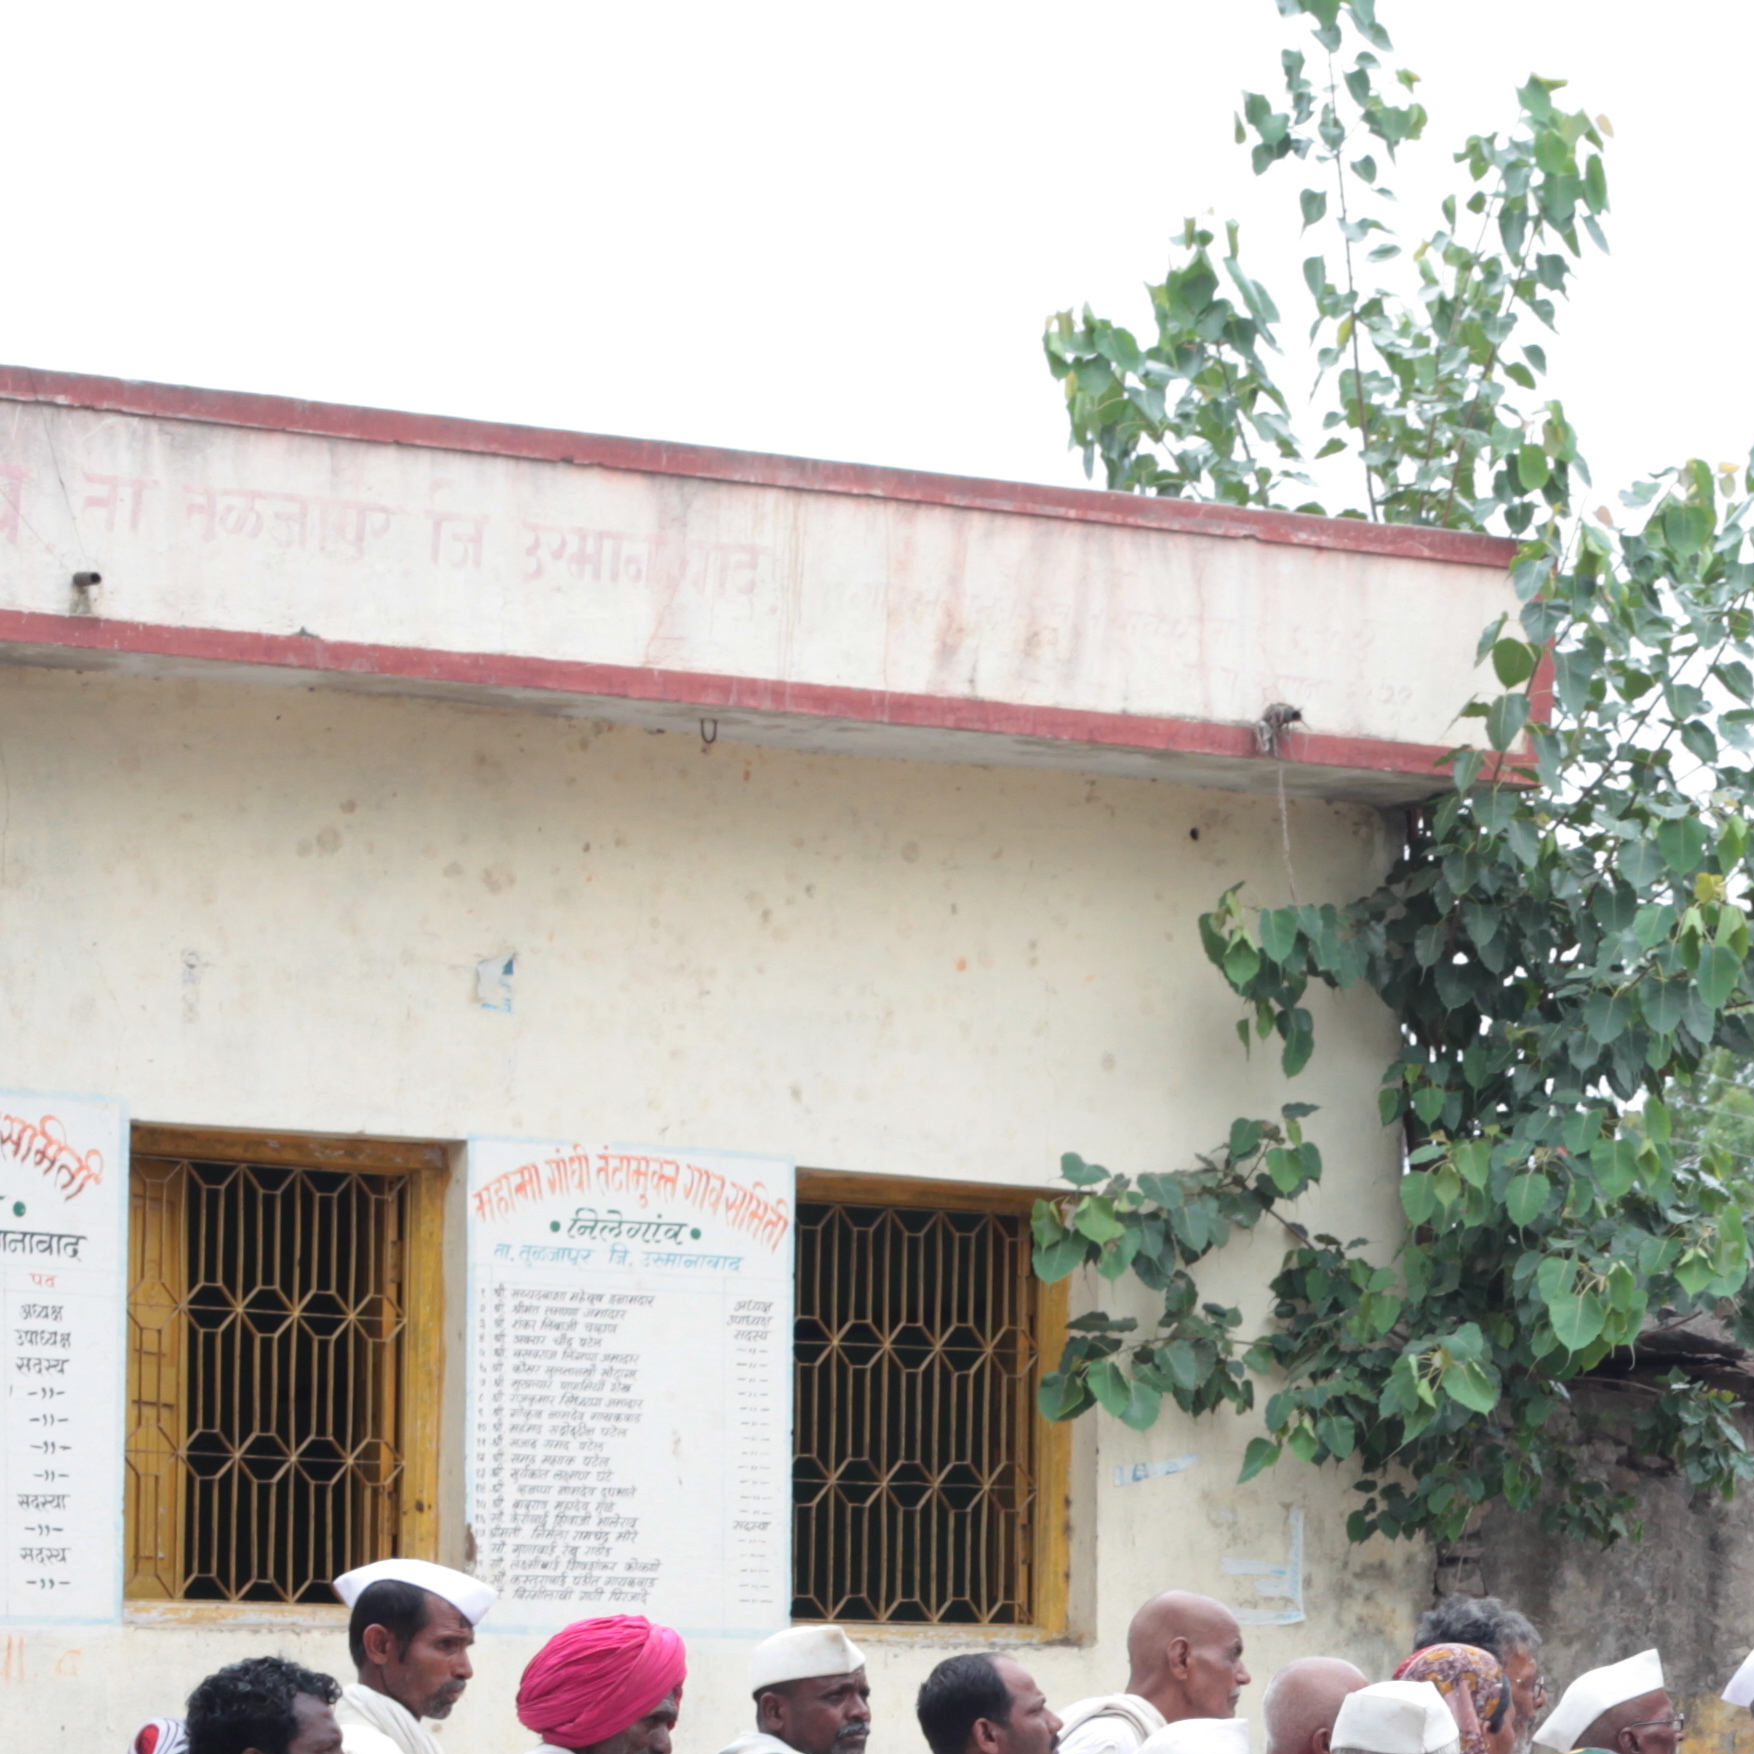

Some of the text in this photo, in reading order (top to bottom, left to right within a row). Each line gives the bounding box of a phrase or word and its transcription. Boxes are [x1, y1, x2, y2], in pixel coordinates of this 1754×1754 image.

[29, 1272, 57, 1288] पद
[20, 1303, 64, 1322] अध्यक्ष
[14, 1328, 72, 1349] उपाध्यक्ष
[16, 1356, 71, 1377] सदस्य
[17, 1493, 71, 1512] सदस्या
[19, 1547, 72, 1567] सदस्य
